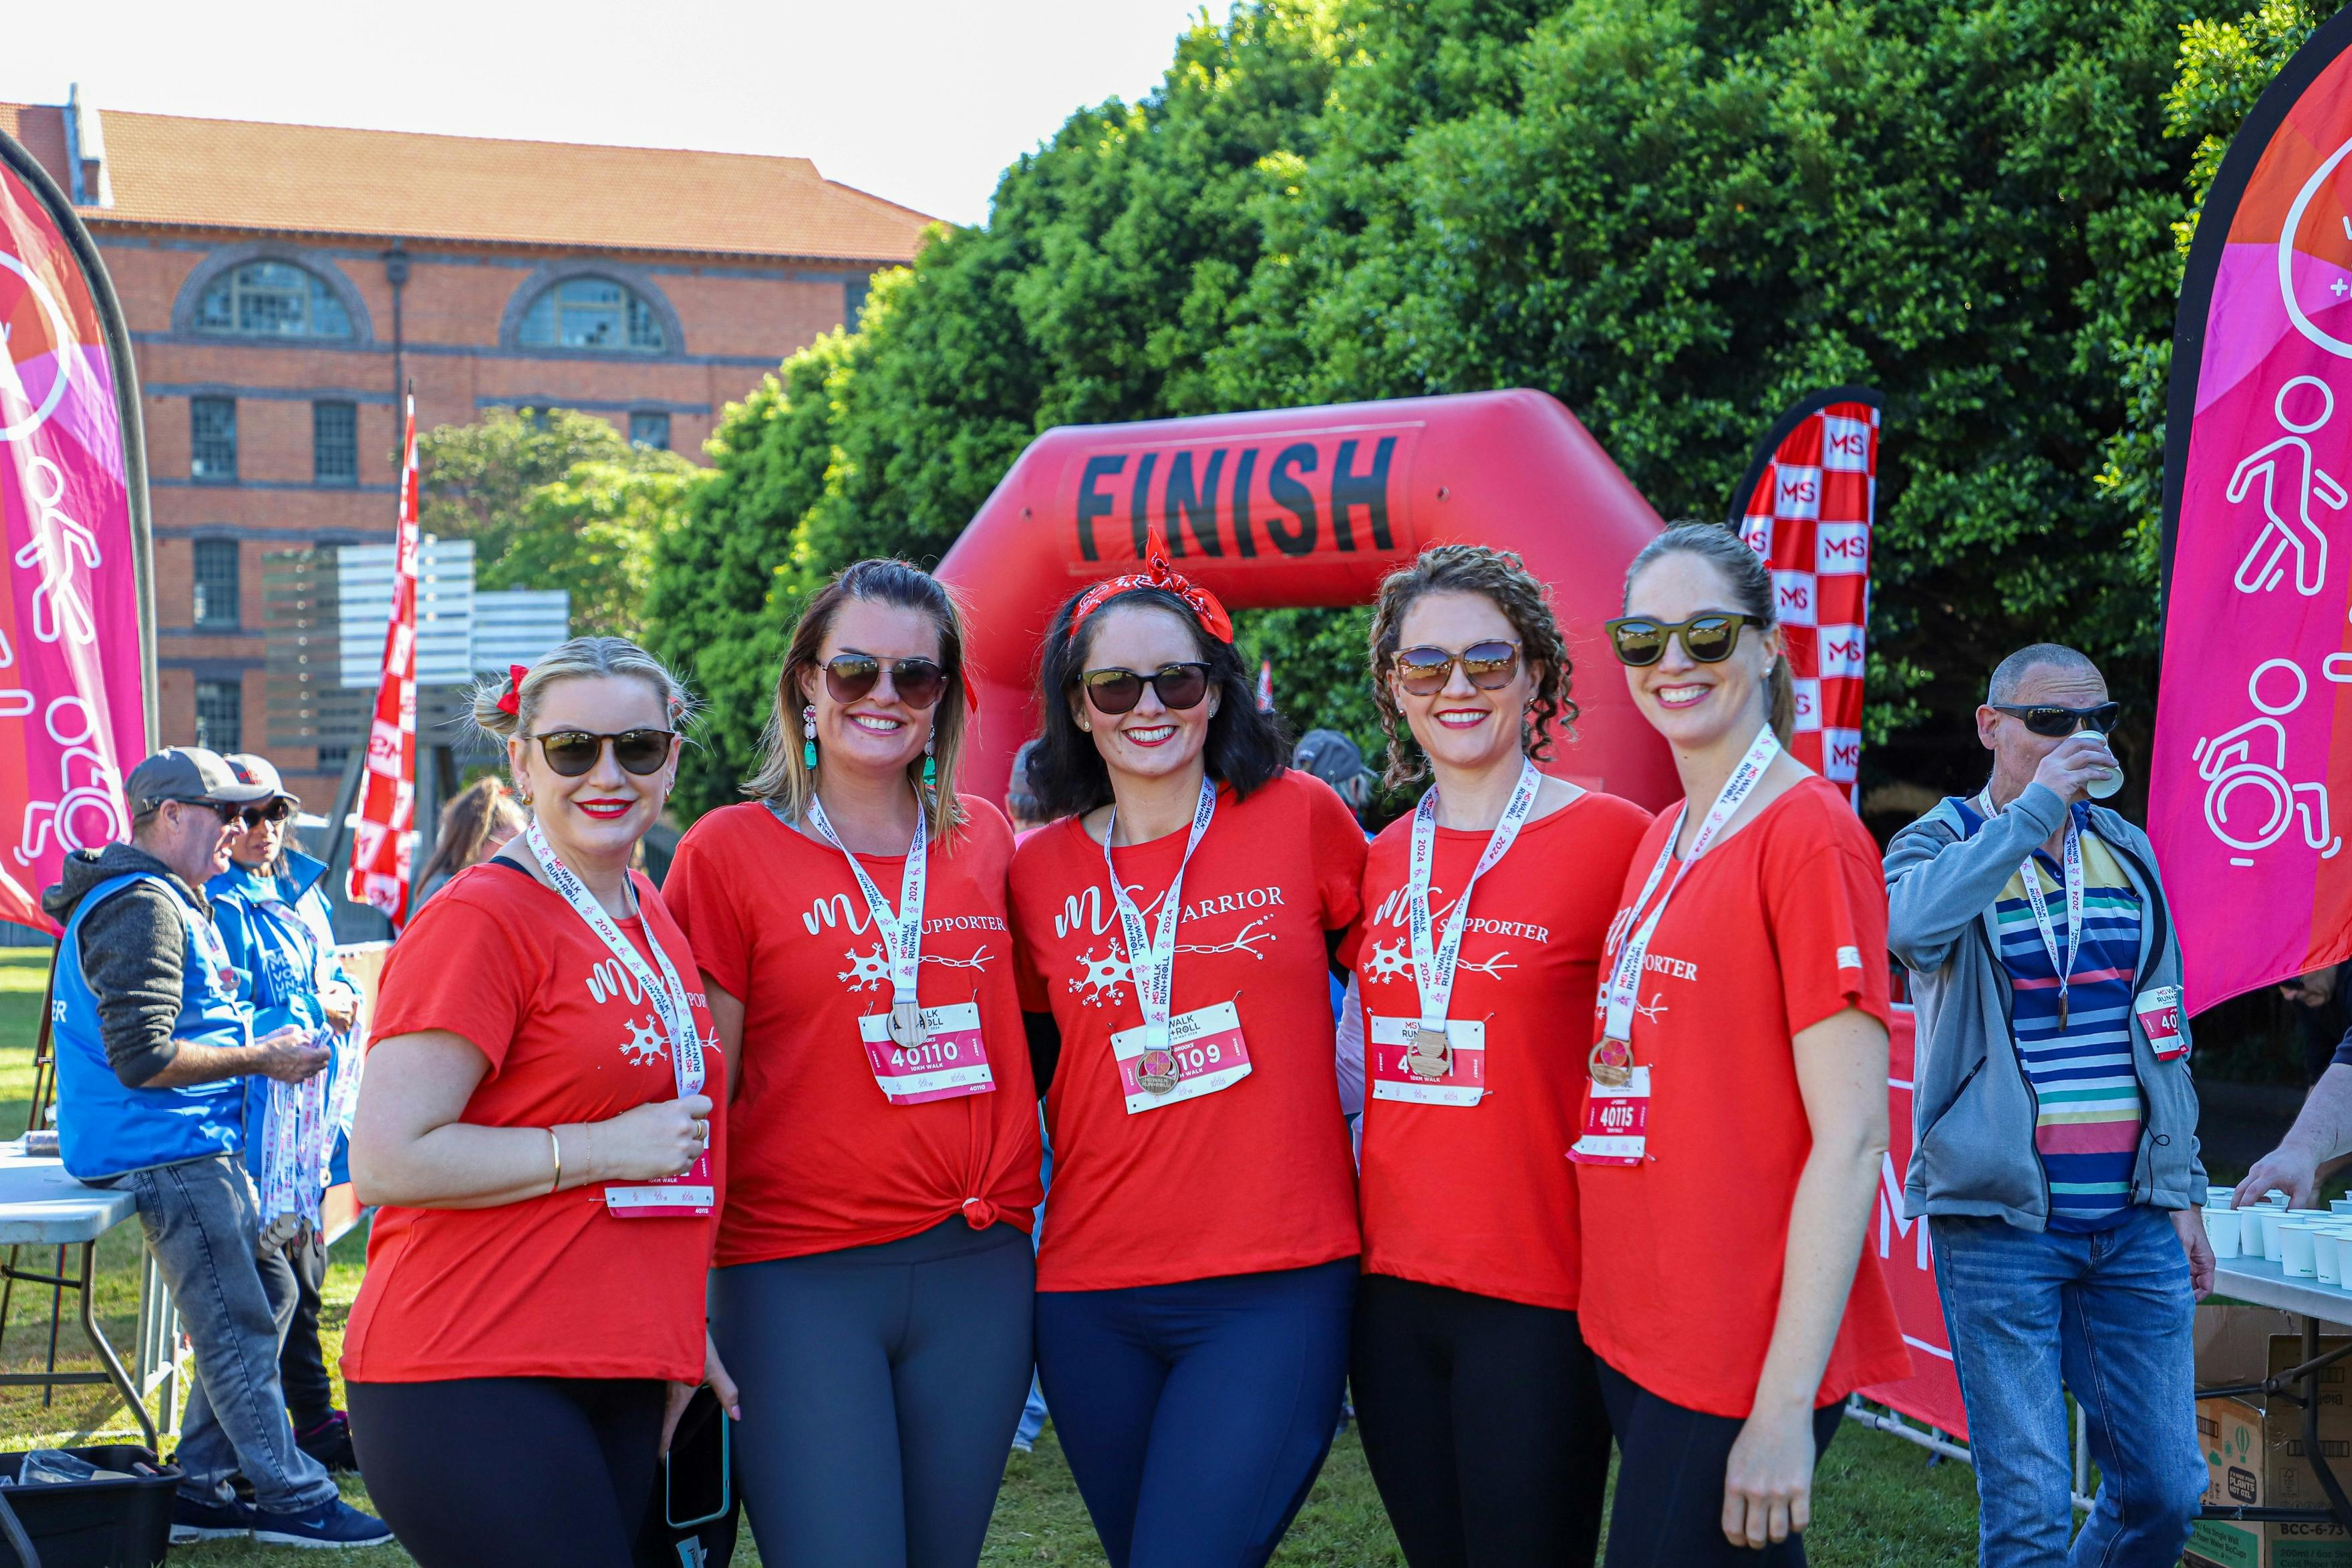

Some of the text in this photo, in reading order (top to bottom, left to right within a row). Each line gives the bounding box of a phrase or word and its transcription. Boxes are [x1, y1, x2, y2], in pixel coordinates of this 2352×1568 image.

[1829, 433, 1864, 456] MS
[1077, 436, 1397, 561] FINISH
[1781, 480, 1815, 503] MS
[1824, 536, 1866, 559] MS
[1780, 587, 1807, 609] MS
[1827, 639, 1861, 662] MS
[1721, 762, 1752, 804] RUN+ROLL
[1731, 779, 1751, 804] WALK
[1195, 792, 1208, 830] RUN+ROLL
[1506, 787, 1525, 819] RUN+ROLL
[1515, 801, 1528, 820] WALK
[1201, 808, 1211, 829] WALK
[1418, 839, 1427, 862] 2024
[1489, 836, 1506, 860] 2024
[545, 863, 578, 905] RUN+ROLL
[561, 869, 582, 893] WALK
[858, 873, 880, 913] RUN+ROLL
[909, 881, 918, 901] 2024
[869, 885, 884, 906] WALK
[2029, 888, 2044, 924] RUN+ROLL
[2037, 898, 2047, 918] WALK
[595, 919, 617, 942] 2024
[920, 916, 1006, 935] UPPORTER
[1163, 909, 1173, 934] 2024
[1437, 917, 1549, 944] SPPORTER
[901, 924, 910, 947] WALK
[908, 919, 918, 959] RUN+ROLL
[1124, 914, 1139, 959] RUN+ROLL
[1134, 927, 1145, 949] WALK
[1439, 945, 1449, 971] WALK
[1442, 937, 1457, 987] RUN+ROLL
[1624, 946, 1637, 973] WALK
[1626, 940, 1645, 990] RUN+ROLL
[1153, 964, 1162, 991] WALK
[1160, 955, 1169, 1005] RUN+ROLL
[1420, 962, 1429, 989] 2024
[640, 977, 668, 1022] RUN+ROLL
[653, 985, 670, 1012] WALK
[51, 999, 67, 1023] ER
[682, 1031, 691, 1058] WALK
[689, 1024, 701, 1072] RUN+ROLL
[891, 1042, 958, 1068] 40110
[972, 1038, 980, 1057] SYDNEY
[1173, 1042, 1195, 1052] BROOKS
[1177, 1044, 1221, 1071] 109
[1185, 1068, 1203, 1077] WALK
[1600, 1106, 1634, 1127] 40115
[1879, 1150, 1931, 1271] M
[2230, 1477, 2255, 1492] PLANTS
[2230, 1486, 2252, 1499] NOT OIL
[2196, 1532, 2209, 1543] Paper
[2210, 1537, 2224, 1549] Water
[2225, 1543, 2246, 1559] BioCups
[2212, 1528, 2226, 1541] Single
[2227, 1534, 2239, 1545] Wall
[2281, 1549, 2309, 1557] 200ml
[2281, 1559, 2302, 1568] Cold
